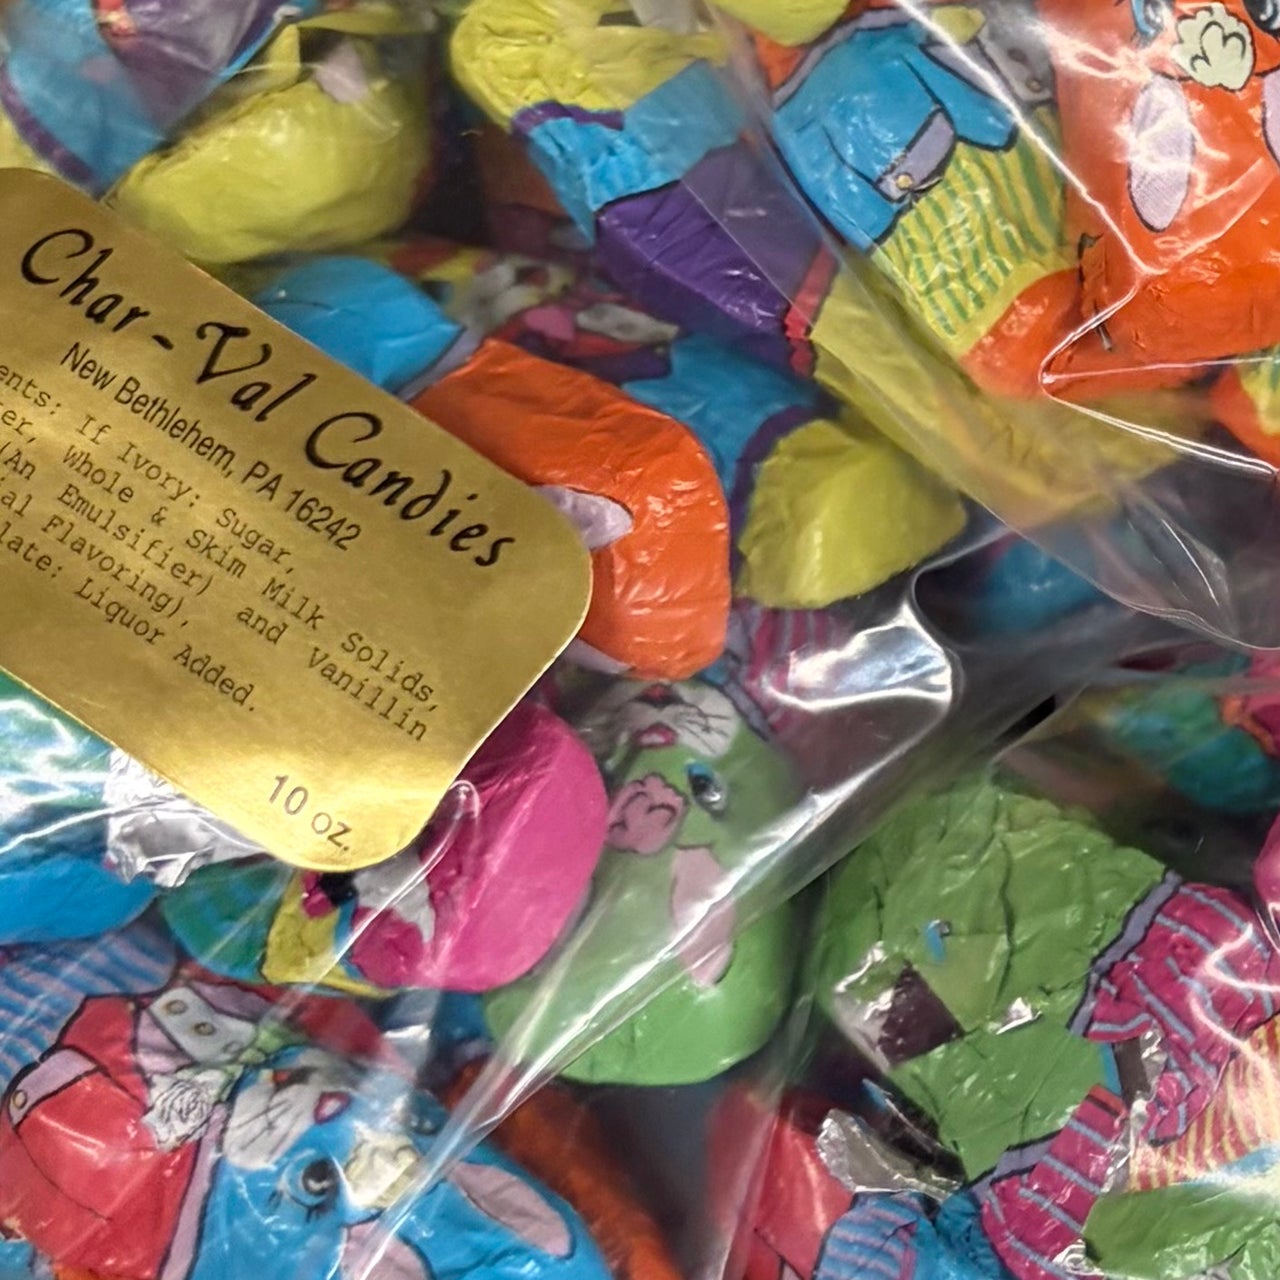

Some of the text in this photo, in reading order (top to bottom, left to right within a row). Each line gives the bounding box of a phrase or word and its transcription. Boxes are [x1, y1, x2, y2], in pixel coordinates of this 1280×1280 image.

[59, 341, 117, 391] New
[112, 375, 236, 478] Bethlehem,
[240, 459, 283, 501] PA
[283, 488, 361, 551] 16242
[75, 413, 112, 445] If
[115, 440, 201, 508] Ivory:
[214, 506, 294, 575] Sugar,
[303, 410, 516, 567] Candies
[40, 513, 189, 628] Flavoring),
[55, 482, 213, 596] Emulsifier)
[235, 606, 289, 645] and
[307, 645, 427, 742] Vanillin
[61, 443, 134, 504] Whole
[149, 505, 168, 527] &
[184, 528, 247, 579] Skim
[260, 576, 324, 631] Milk
[339, 631, 438, 712] Solids,
[73, 575, 165, 646] Liquor
[171, 643, 255, 712] Added.
[268, 774, 352, 852] 10 oz.
